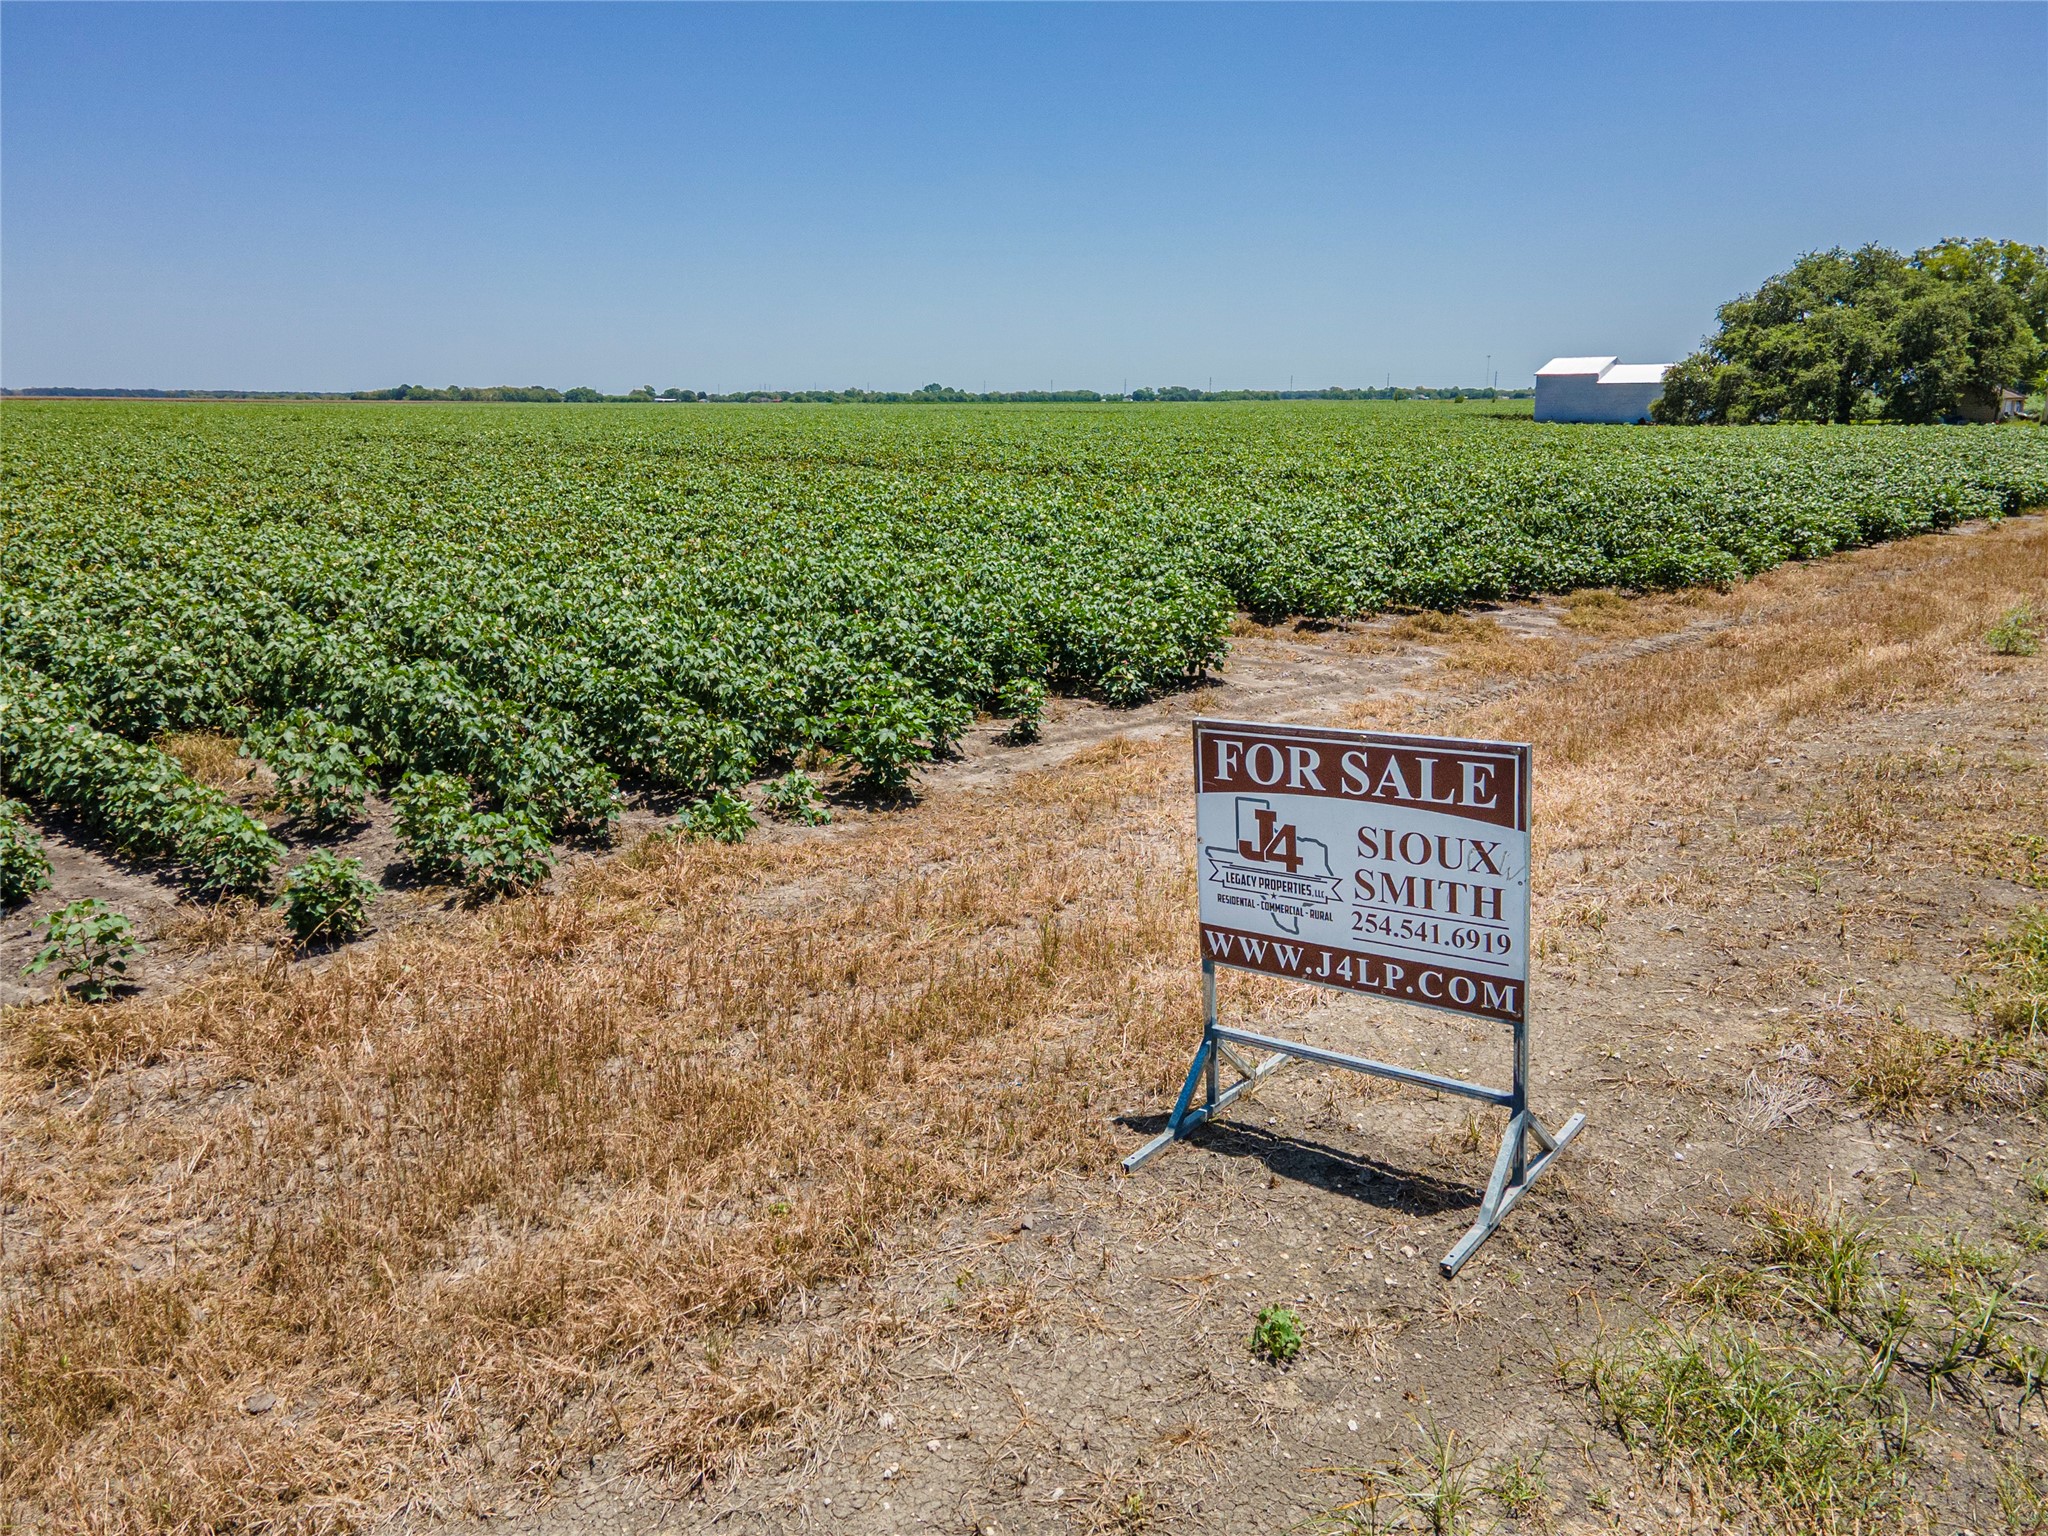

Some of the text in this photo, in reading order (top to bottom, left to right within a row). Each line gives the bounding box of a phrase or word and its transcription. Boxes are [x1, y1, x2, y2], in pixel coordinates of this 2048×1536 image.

[1213, 739, 1497, 810] FOR SALE
[1238, 809, 1303, 873] J4
[1357, 826, 1503, 875] SIOUX
[1226, 872, 1257, 888] LEGACY
[1354, 869, 1506, 922] SMITH
[1260, 901, 1304, 917] COMMERCIAL
[1309, 910, 1333, 922] RURAL
[1352, 911, 1511, 955] 254.541.6919
[1204, 929, 1518, 1014] WWW.J4LP.COM
